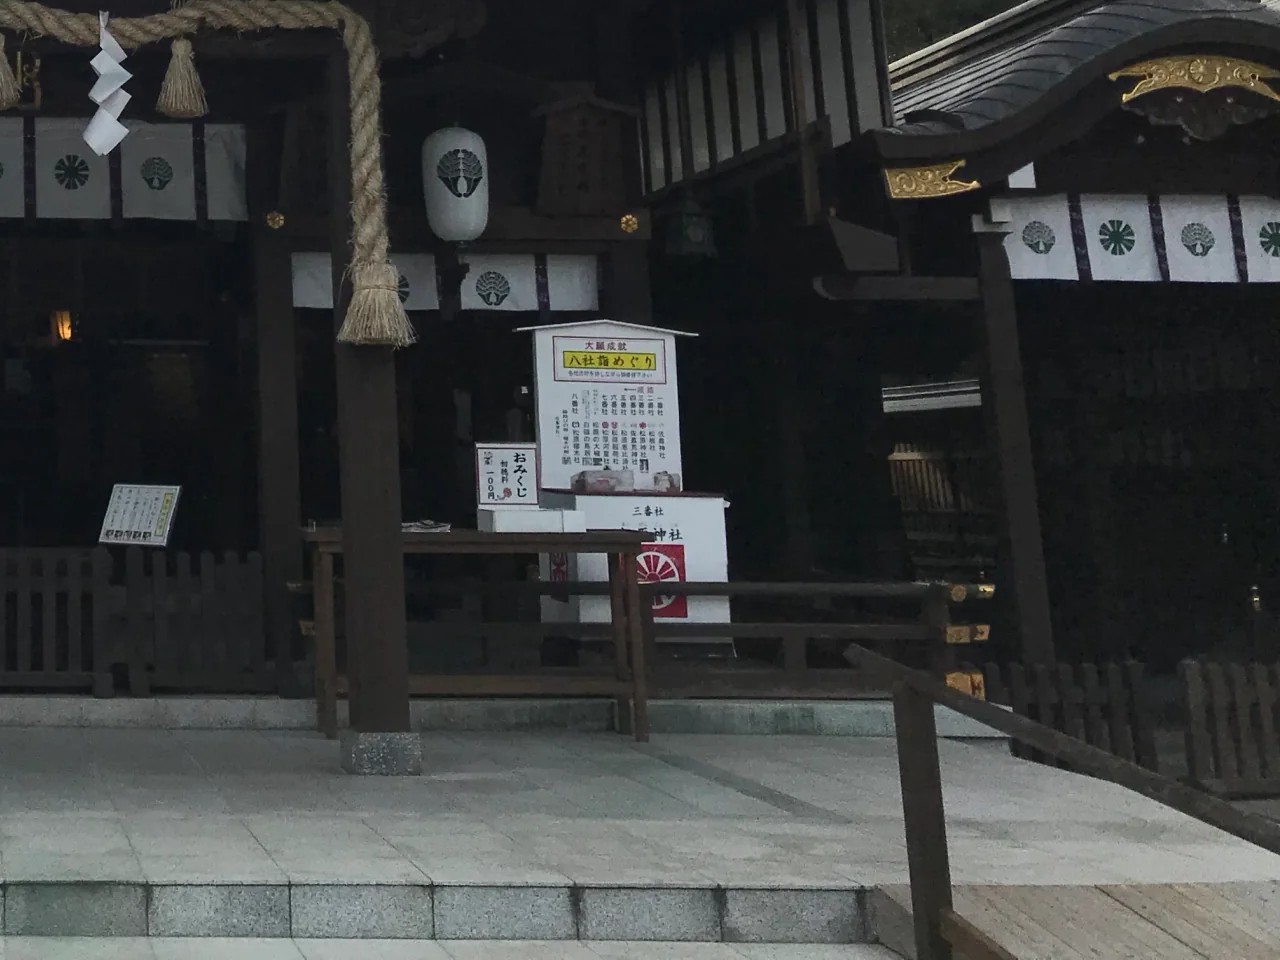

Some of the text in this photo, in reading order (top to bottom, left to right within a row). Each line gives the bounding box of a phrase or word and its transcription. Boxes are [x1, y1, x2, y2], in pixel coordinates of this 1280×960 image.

[569, 355, 652, 368] 八社詣めぐり
[500, 459, 508, 484] 初穂料
[513, 452, 528, 498] おみくじ
[632, 505, 664, 516] 三番社
